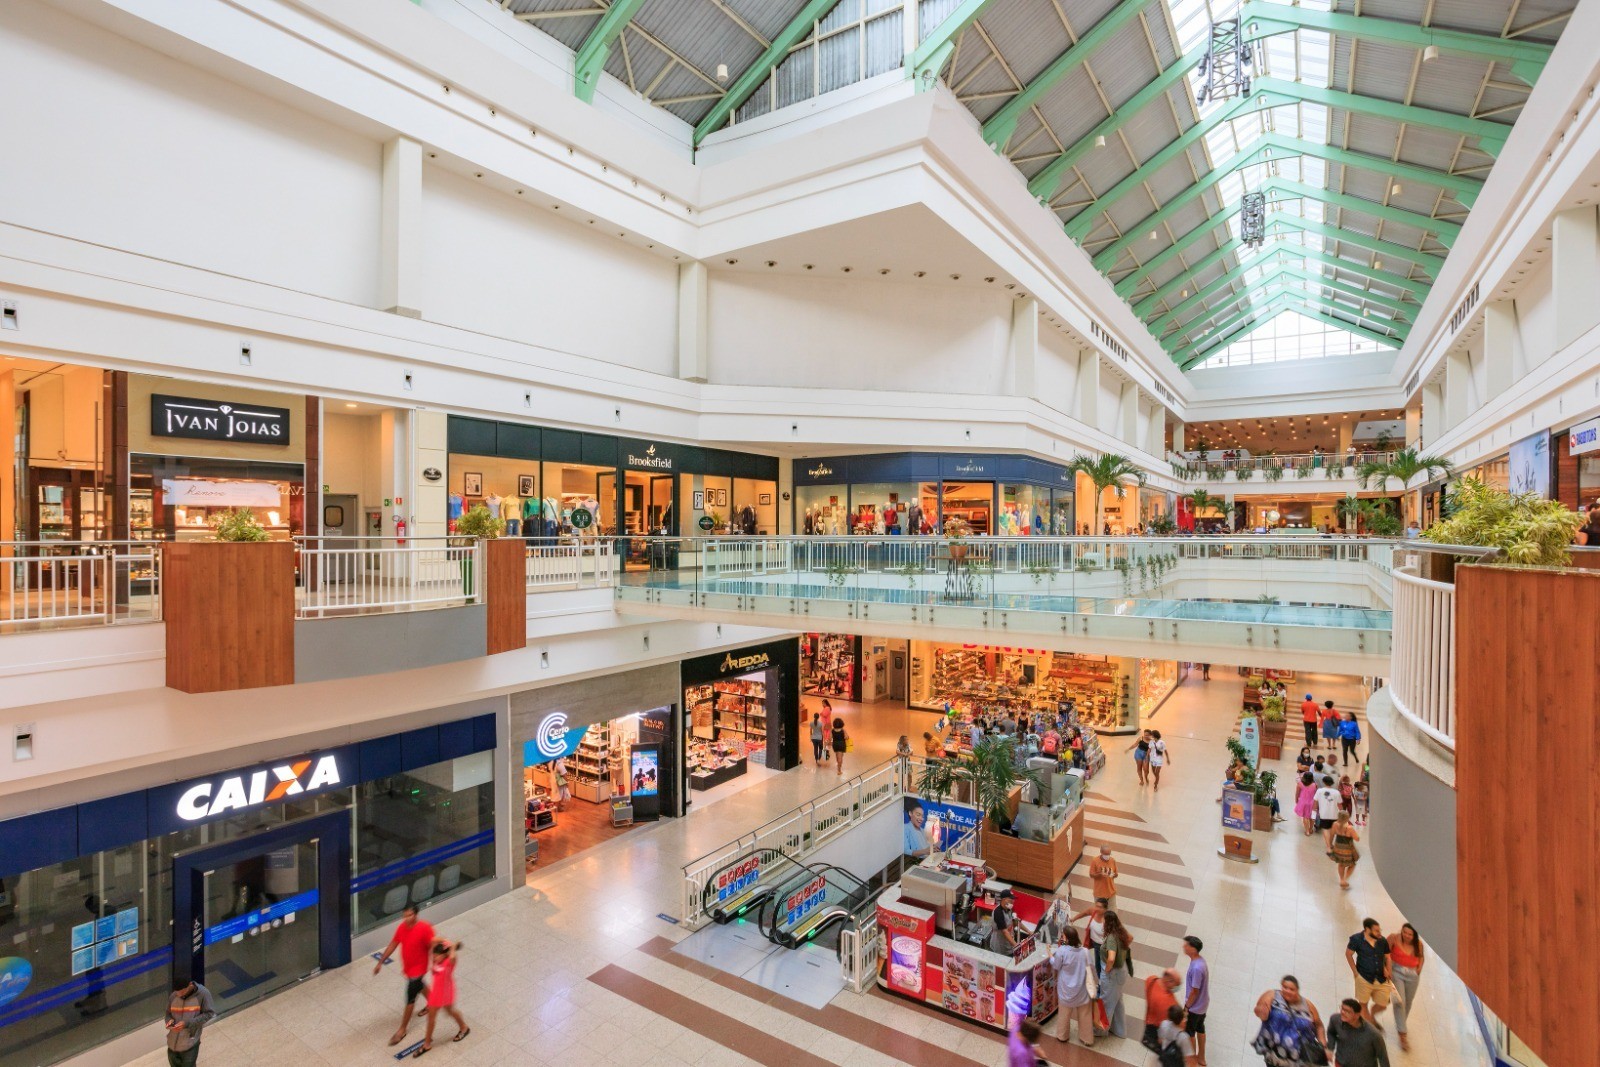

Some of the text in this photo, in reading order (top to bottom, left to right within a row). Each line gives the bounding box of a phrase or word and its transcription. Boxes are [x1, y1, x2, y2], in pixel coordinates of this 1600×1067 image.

[166, 409, 281, 438] IVAN JOIAS
[628, 454, 672, 468] Brooksfield
[176, 755, 341, 820] CAIXA
